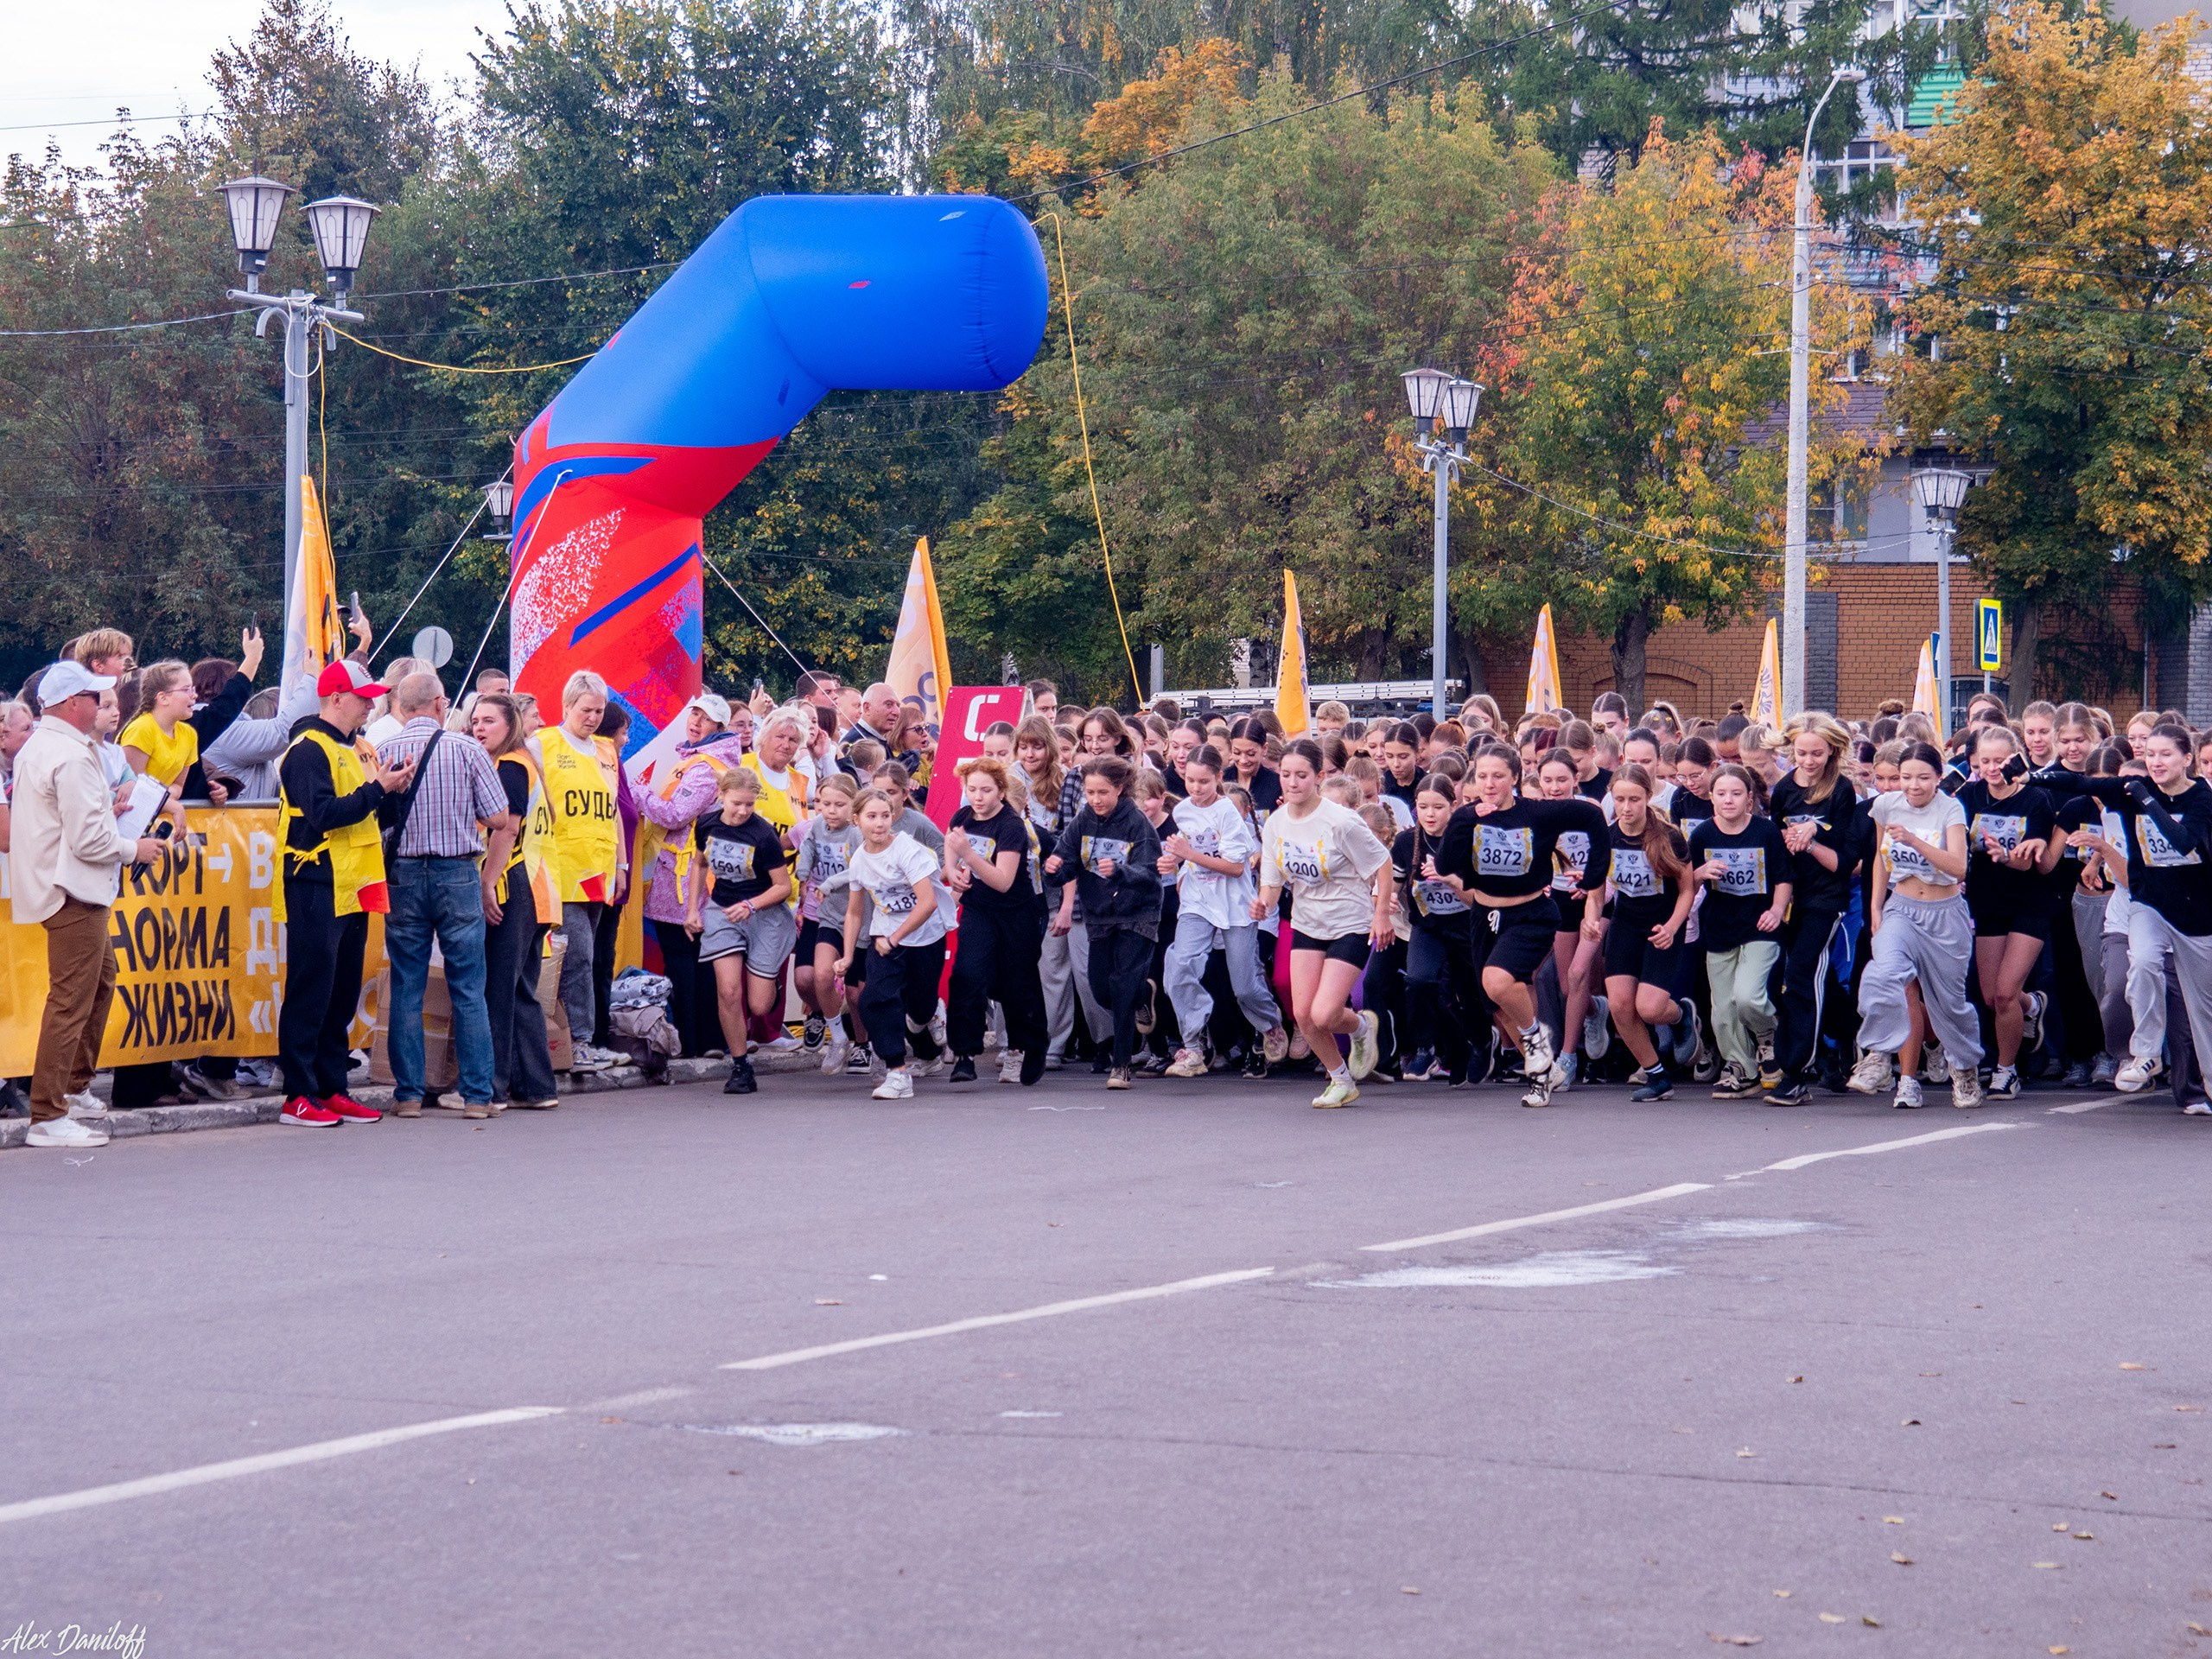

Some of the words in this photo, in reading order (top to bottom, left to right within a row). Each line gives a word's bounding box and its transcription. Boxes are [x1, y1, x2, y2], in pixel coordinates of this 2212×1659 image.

[1482, 847, 1522, 866] 3872
[1891, 849, 1930, 867] 3502
[711, 858, 742, 874] 1591
[1285, 861, 1319, 878] 1200
[1616, 872, 1651, 888] 4421
[111, 905, 231, 974] НОРМА
[117, 979, 236, 1050] ЖИЗНИ
